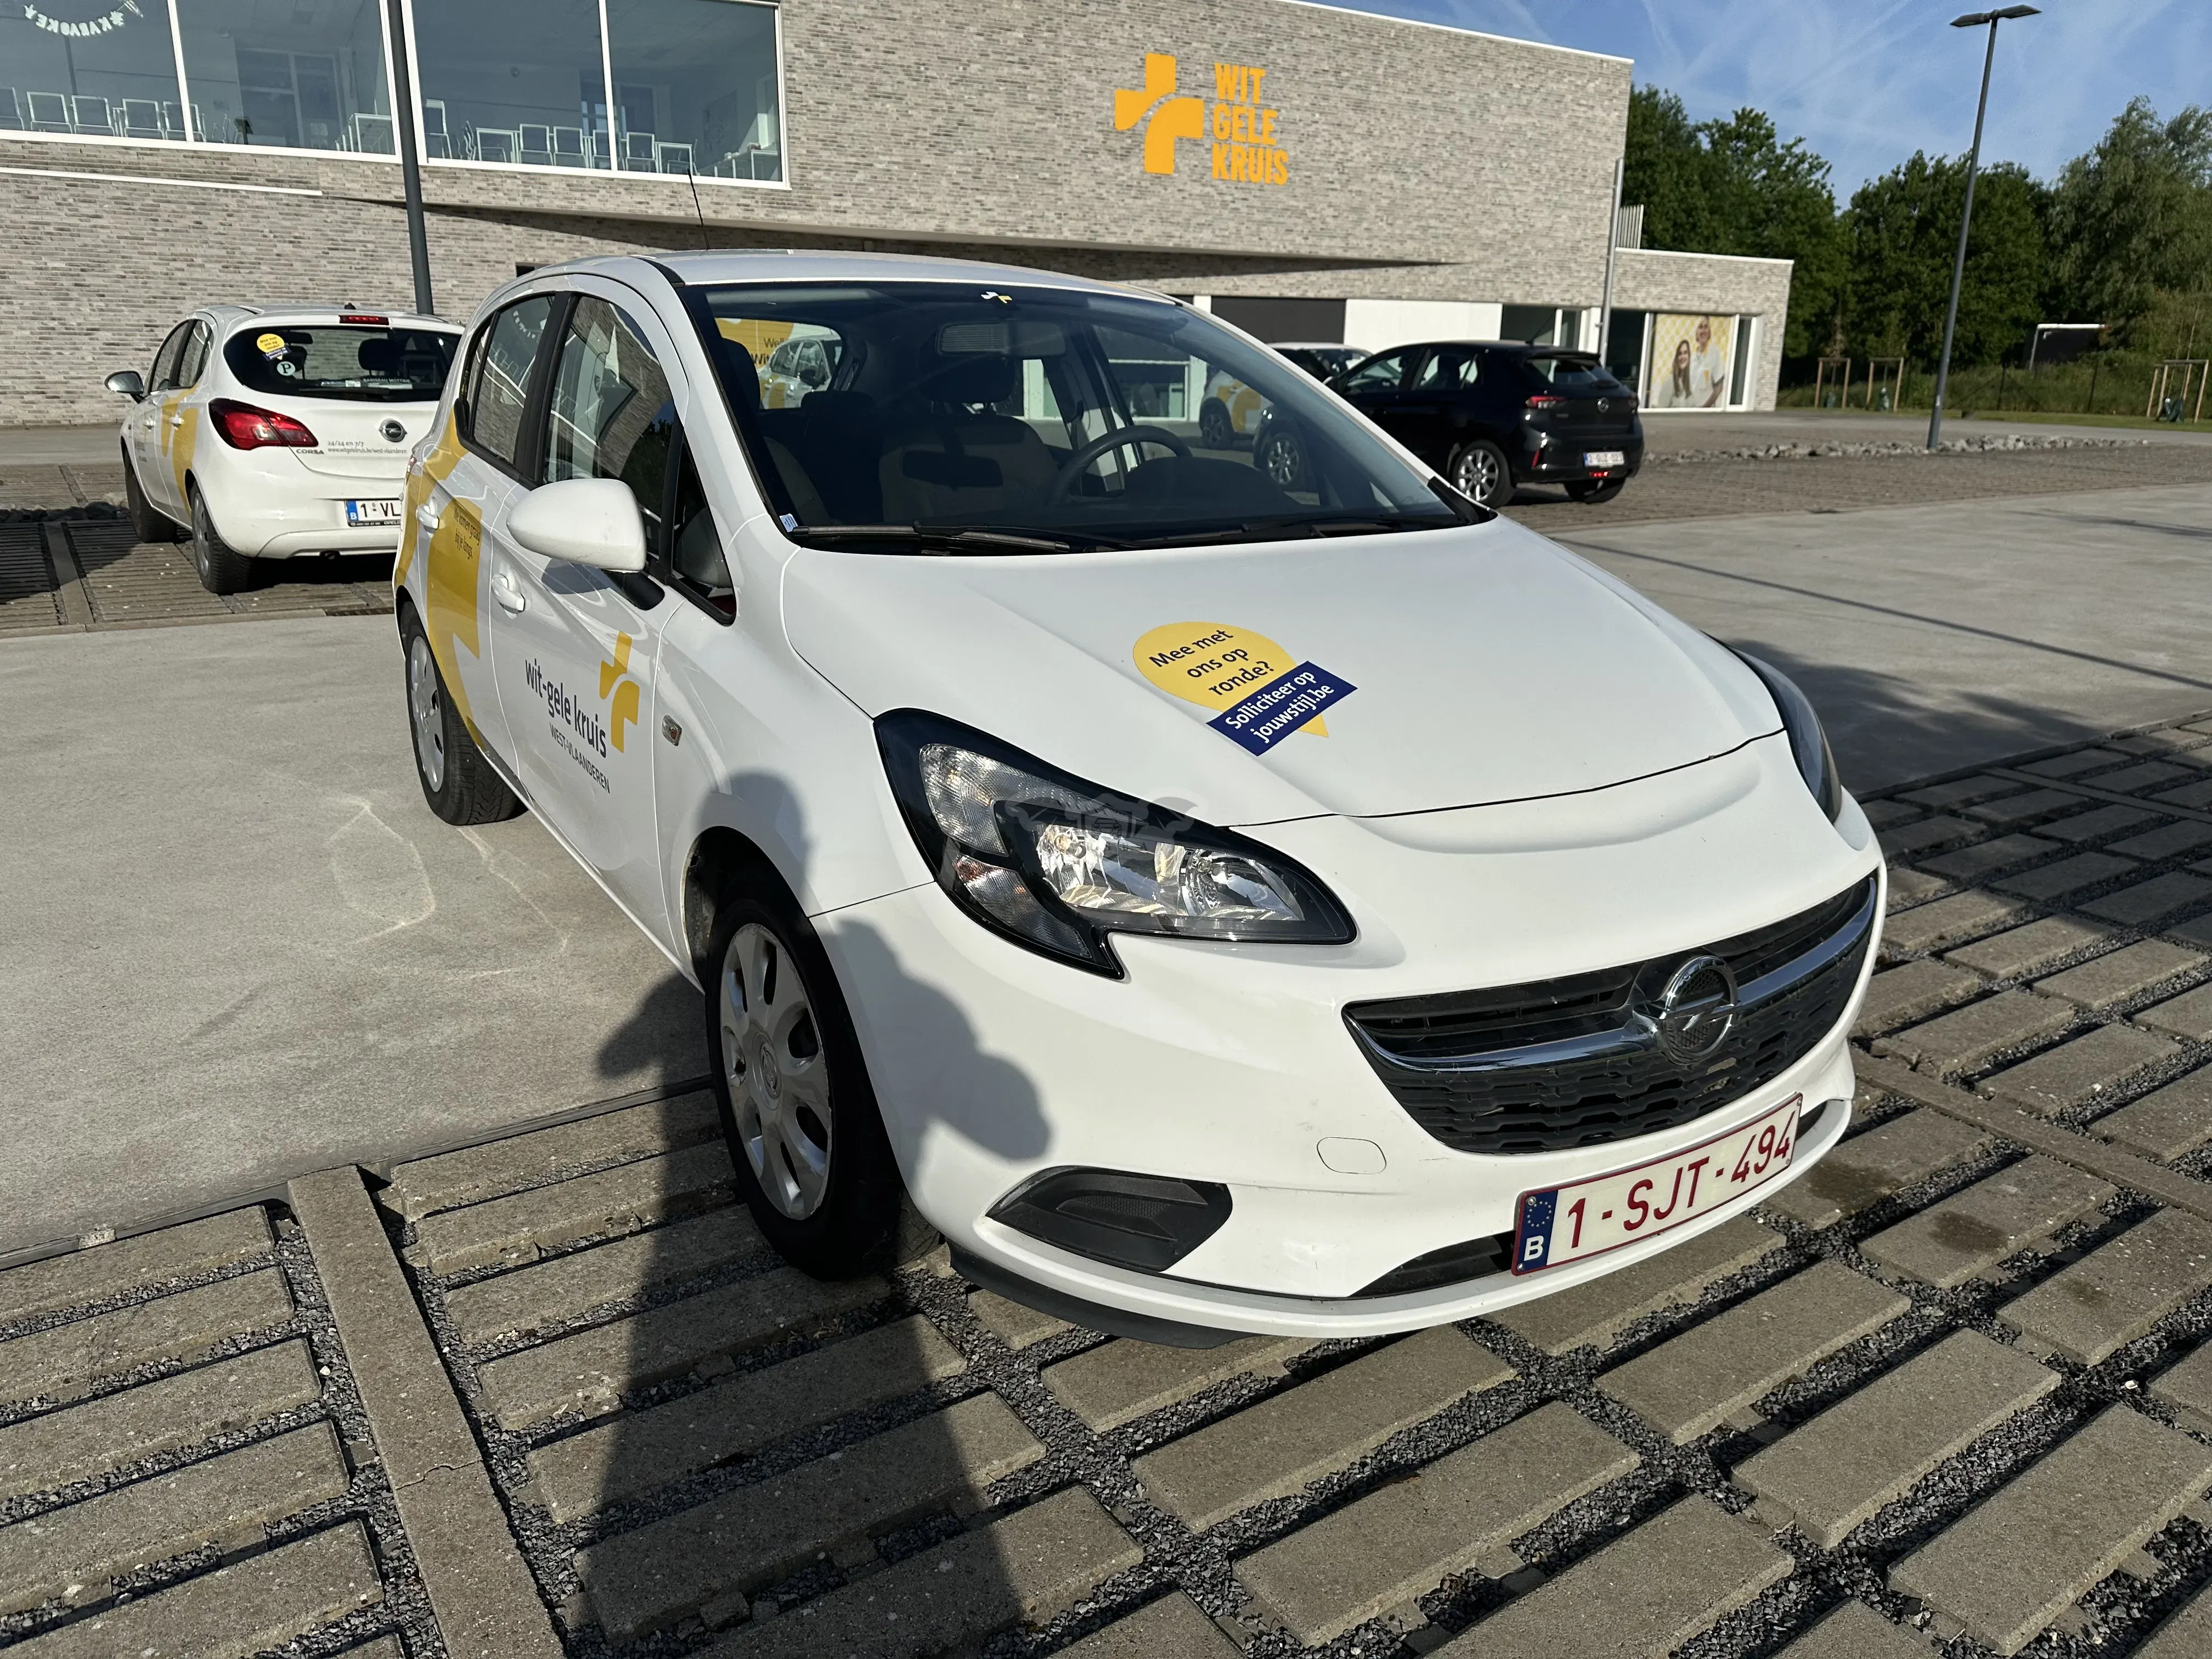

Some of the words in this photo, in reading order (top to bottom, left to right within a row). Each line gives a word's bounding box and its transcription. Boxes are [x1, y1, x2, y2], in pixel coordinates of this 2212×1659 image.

[1214, 63, 1265, 104] WIT
[1213, 103, 1278, 145] GELE
[1212, 143, 1289, 185] KRUIS
[280, 363, 291, 374] P
[1148, 645, 1194, 668] Mee
[1192, 629, 1234, 649] met
[1187, 657, 1223, 678] ons
[1222, 647, 1249, 662] op
[1208, 661, 1274, 696] ronde?
[1225, 681, 1297, 729] Solliciteer
[1294, 670, 1317, 686] op
[525, 658, 571, 725] wit-gele
[574, 695, 607, 758] kruis
[1250, 684, 1335, 744] jouwstijl.be
[549, 722, 611, 794] WEST-VLAANDEREN
[1523, 1235, 1543, 1261] B
[1567, 1110, 1796, 1249] 1-SJT-494
